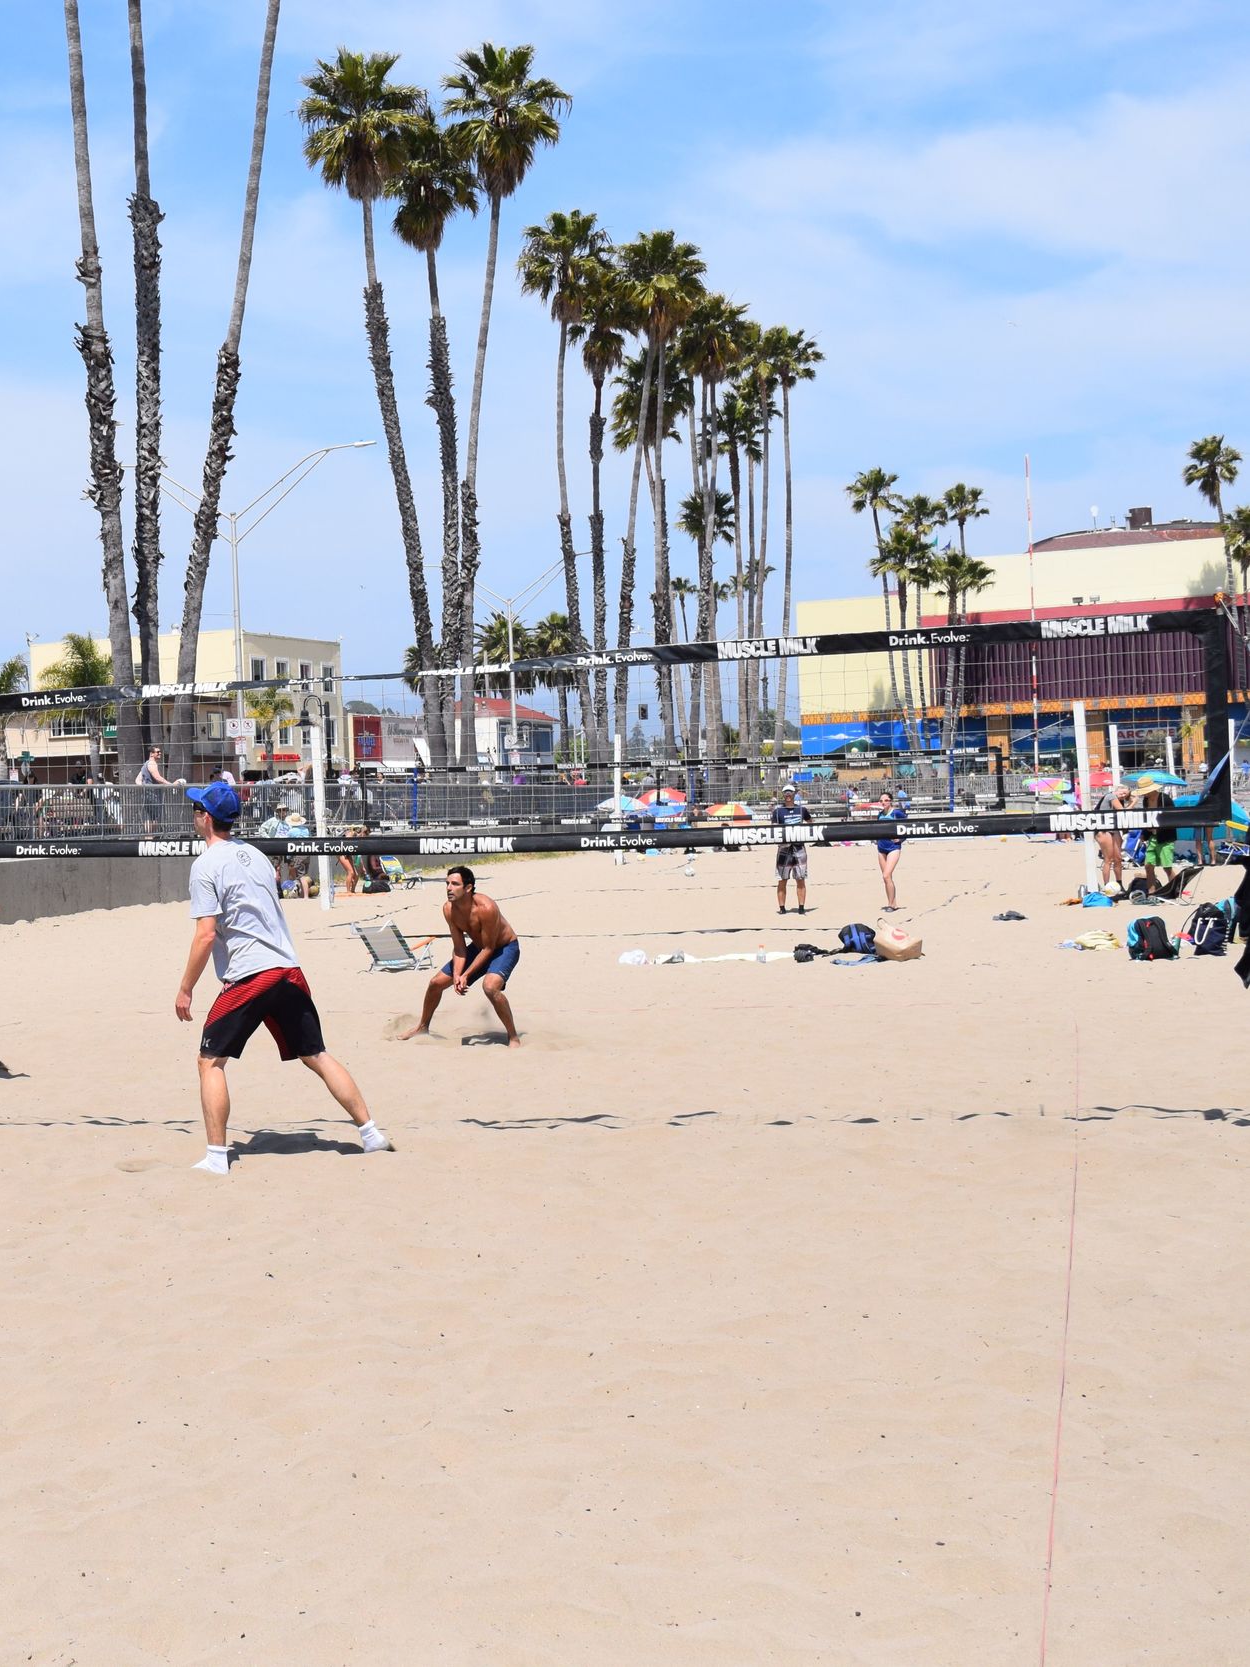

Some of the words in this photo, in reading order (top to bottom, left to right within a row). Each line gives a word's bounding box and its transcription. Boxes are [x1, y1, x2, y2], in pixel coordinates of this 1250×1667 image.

[1040, 618, 1105, 638] MUSCLE
[1107, 615, 1150, 634] MILK
[889, 633, 930, 646] Drink.
[717, 640, 777, 659] MUSCLE
[778, 637, 819, 656] MILK
[476, 662, 511, 674] MILK
[142, 684, 193, 698] MUSCLE
[193, 682, 227, 694] MILK
[1050, 813, 1114, 831] MUSCLE
[1117, 810, 1160, 829] MILK
[723, 827, 782, 844] MUSCLE
[786, 826, 825, 842] MILK
[896, 824, 937, 835] Drink.
[16, 845, 48, 855] Drink.
[138, 840, 190, 856] MUSCLE
[287, 842, 322, 852] Drink.
[420, 838, 475, 854] MUSCLE
[477, 837, 513, 852] MILK
[580, 837, 619, 847] Drink.
